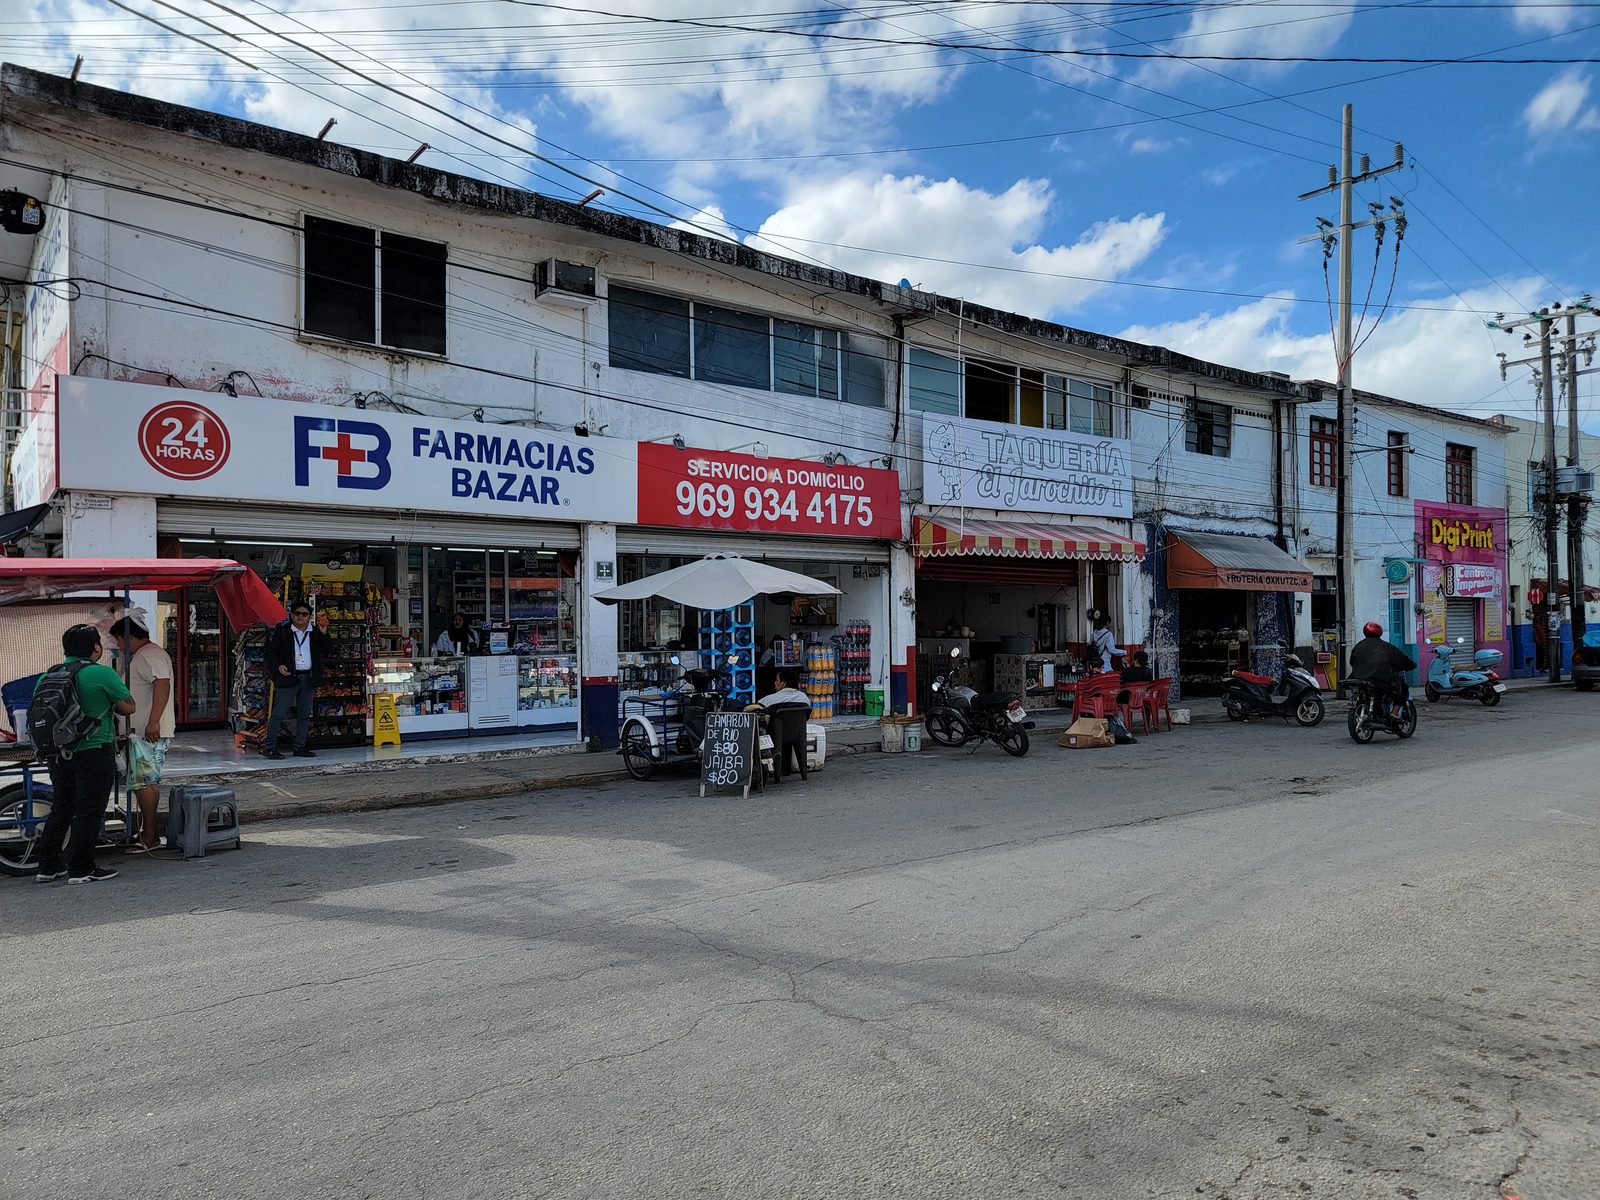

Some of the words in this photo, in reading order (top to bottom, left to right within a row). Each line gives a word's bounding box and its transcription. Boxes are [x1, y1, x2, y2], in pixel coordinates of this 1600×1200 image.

[161, 418, 208, 448] 24
[156, 445, 215, 462] HORAS
[412, 427, 595, 475] FARMACIAS
[981, 431, 1126, 476] TAQUERÍA
[687, 459, 768, 483] SERVICIO
[770, 470, 783, 484] A
[787, 469, 865, 491] DOMICILIO
[452, 467, 560, 506] BAZAR
[977, 464, 1002, 498] El
[1004, 467, 1109, 507] Jarochito
[1112, 479, 1123, 507] I
[676, 480, 735, 519] 969
[744, 486, 799, 522] 934
[806, 491, 873, 527] 4175
[1226, 573, 1263, 584] FRUTERÍA
[1458, 567, 1484, 578] Centro
[1456, 576, 1493, 591] impresión
[707, 729, 720, 739] DE
[712, 741, 739, 755] $80
[704, 755, 744, 769] JAIBA
[707, 769, 738, 785] $80
